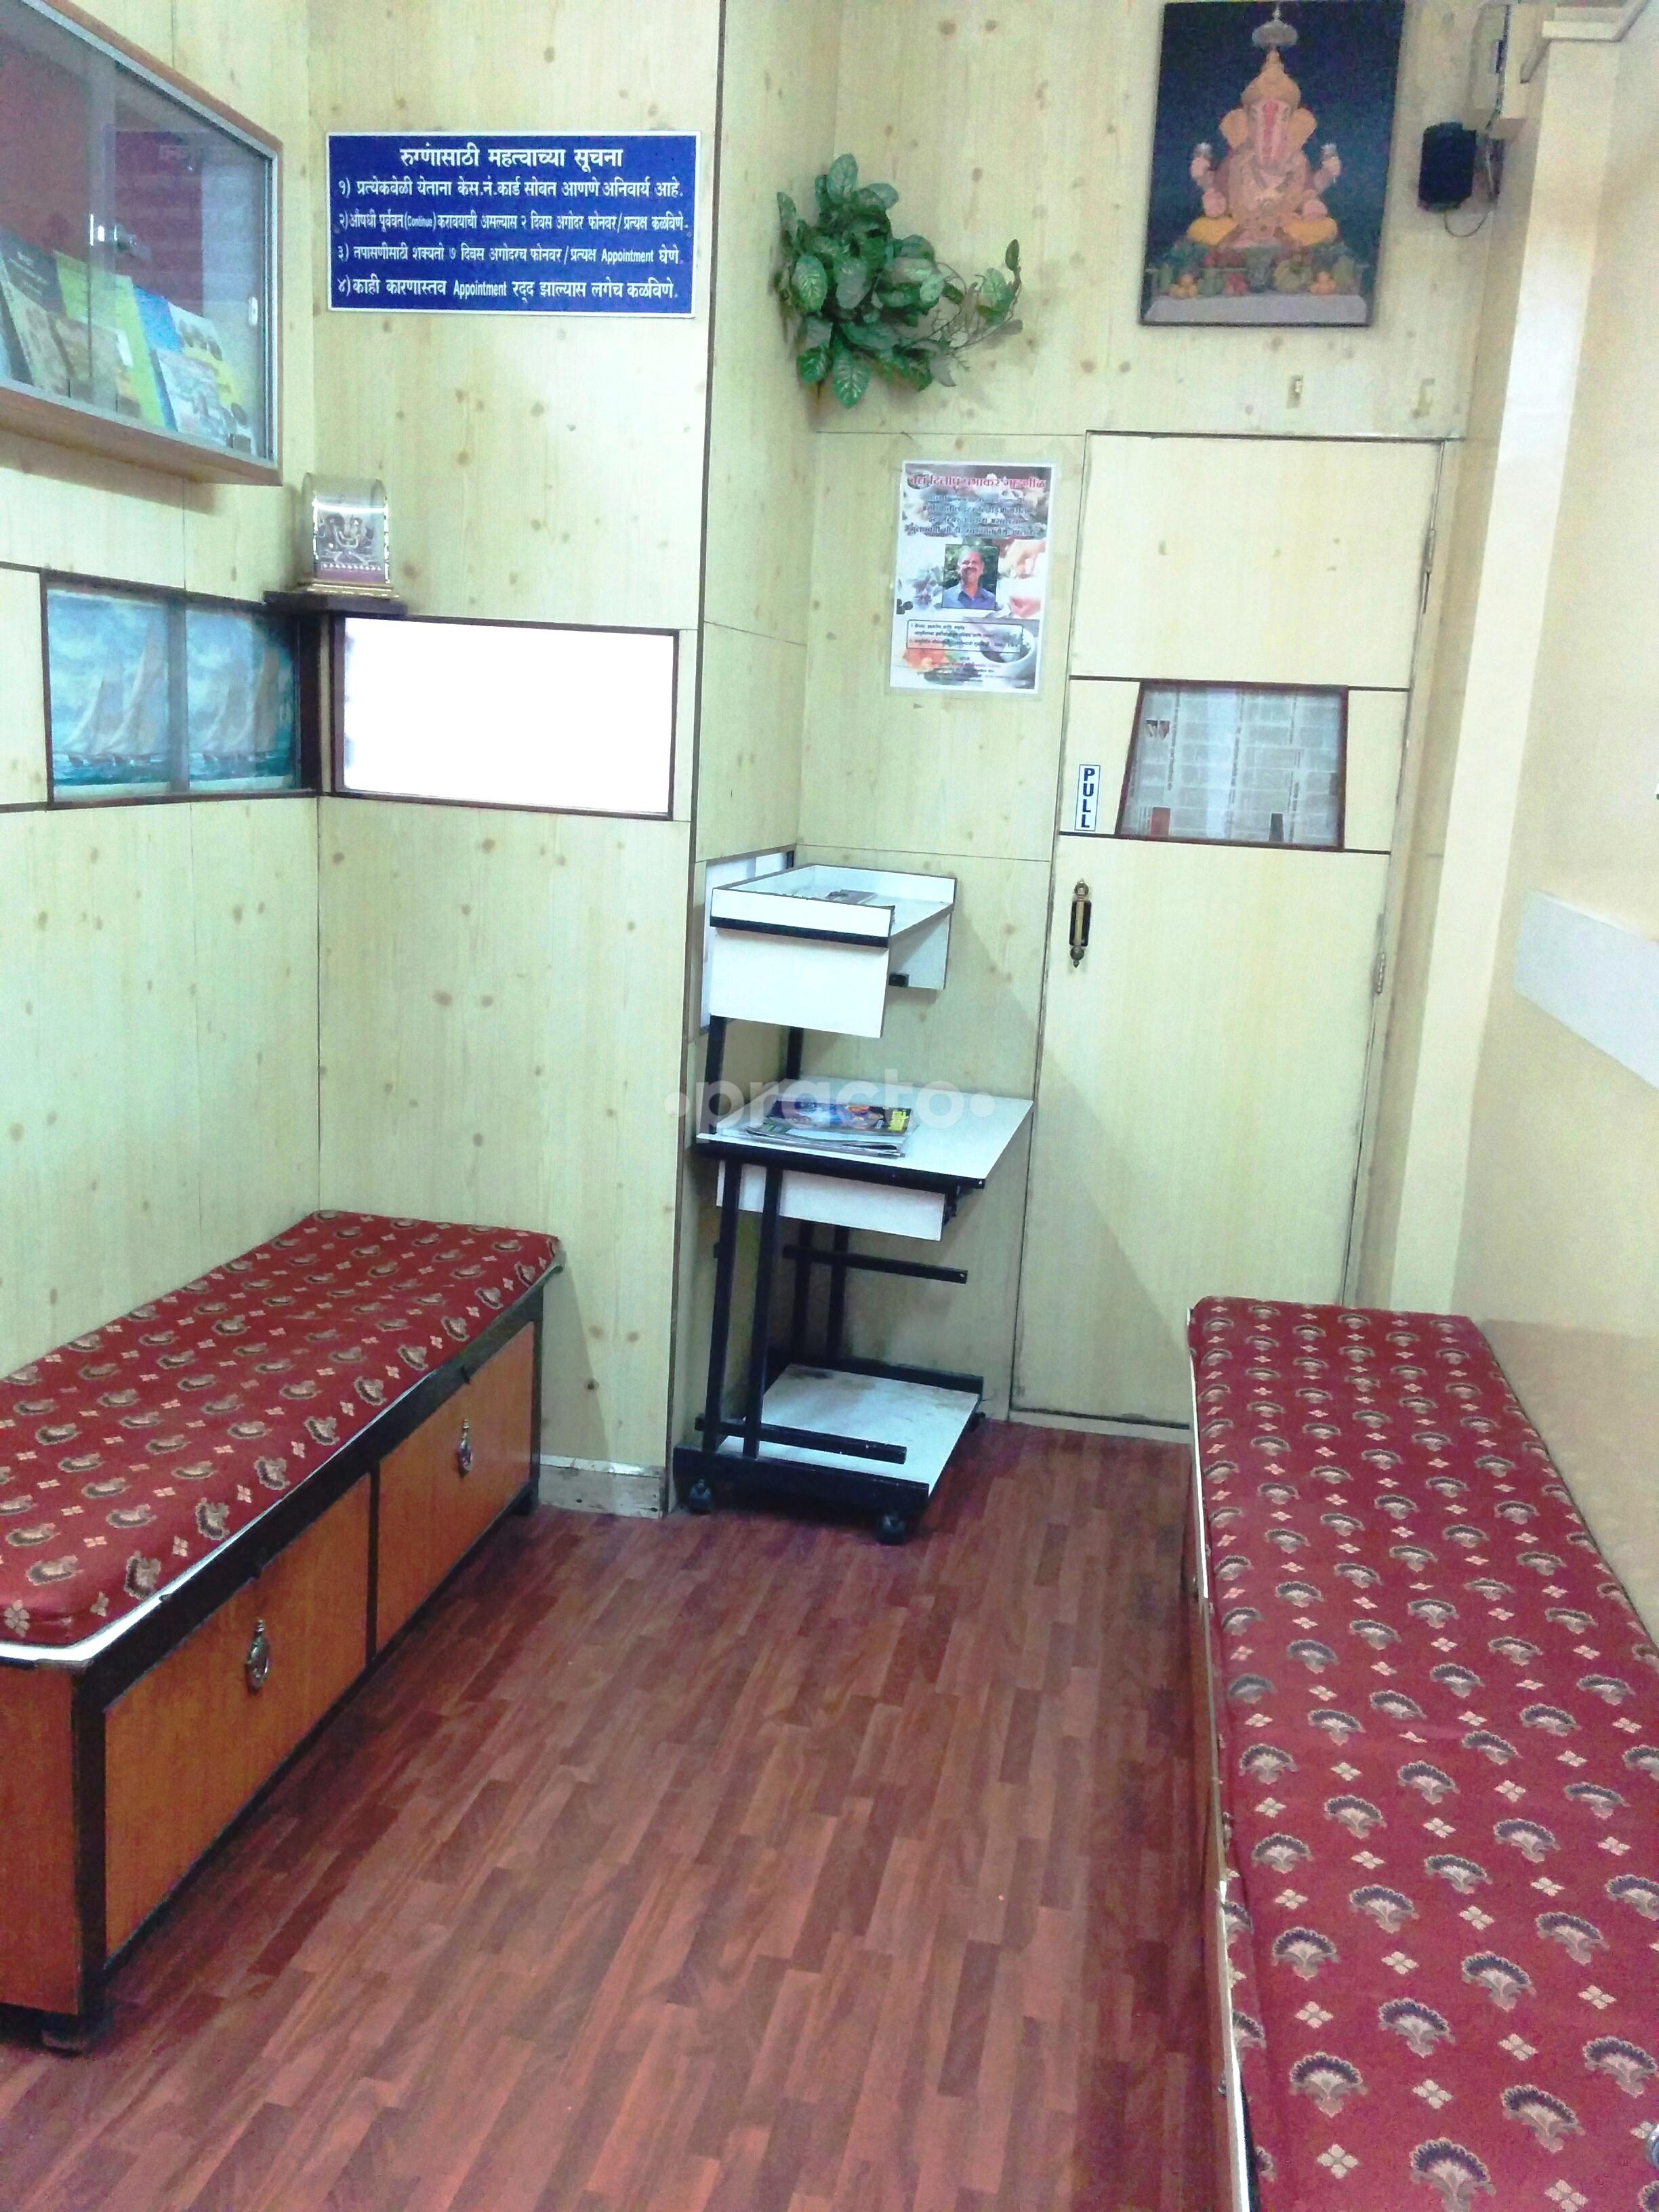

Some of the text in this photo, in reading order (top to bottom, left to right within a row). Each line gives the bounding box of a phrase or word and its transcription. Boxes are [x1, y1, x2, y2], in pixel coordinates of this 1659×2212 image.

[488, 148, 566, 167] महत्वाच्या
[574, 148, 623, 173] सूचना
[356, 175, 413, 196] प्रत्येकवेळी
[417, 176, 452, 196] येताना
[562, 176, 600, 197] आणणे
[602, 176, 651, 197] अनिवार्य
[520, 215, 527, 229] २
[531, 210, 553, 230] दिवस
[556, 210, 584, 230] अगोदर
[412, 241, 445, 260] शक्यतो
[449, 247, 457, 260] ७
[460, 243, 485, 261] दिवस
[601, 248, 654, 265] Appointment
[352, 272, 380, 295] काही
[386, 279, 447, 295] कारणास्तव
[453, 279, 507, 300] Appointment
[539, 281, 587, 298] झाल्यास
[591, 276, 623, 298] लगेच
[1081, 767, 1096, 828] PULL
